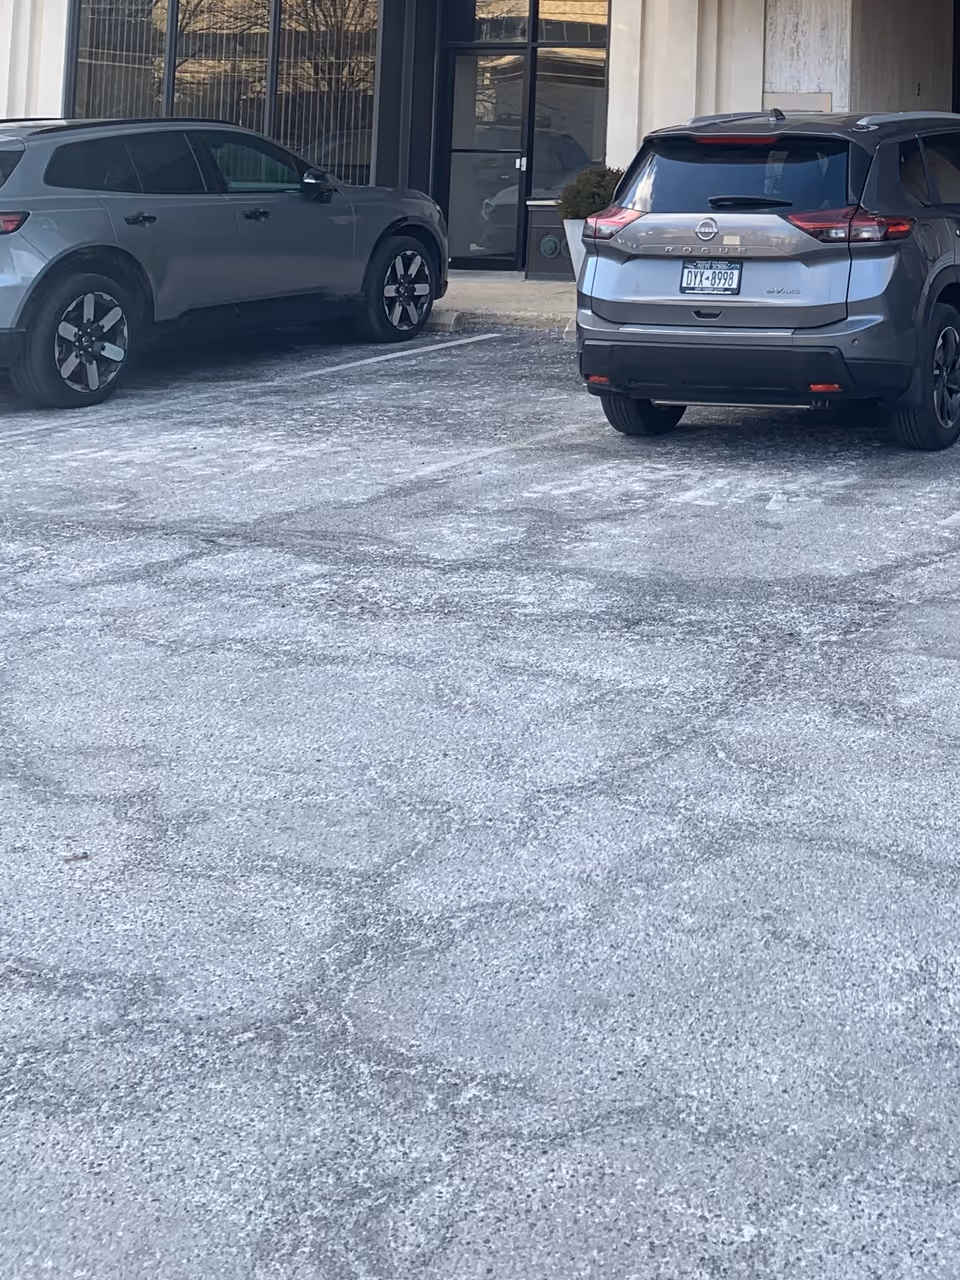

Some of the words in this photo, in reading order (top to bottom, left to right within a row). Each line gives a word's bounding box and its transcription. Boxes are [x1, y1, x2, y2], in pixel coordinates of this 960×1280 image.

[665, 246, 747, 254] ROGUE
[686, 270, 705, 286] DYX
[710, 271, 734, 287] 8998
